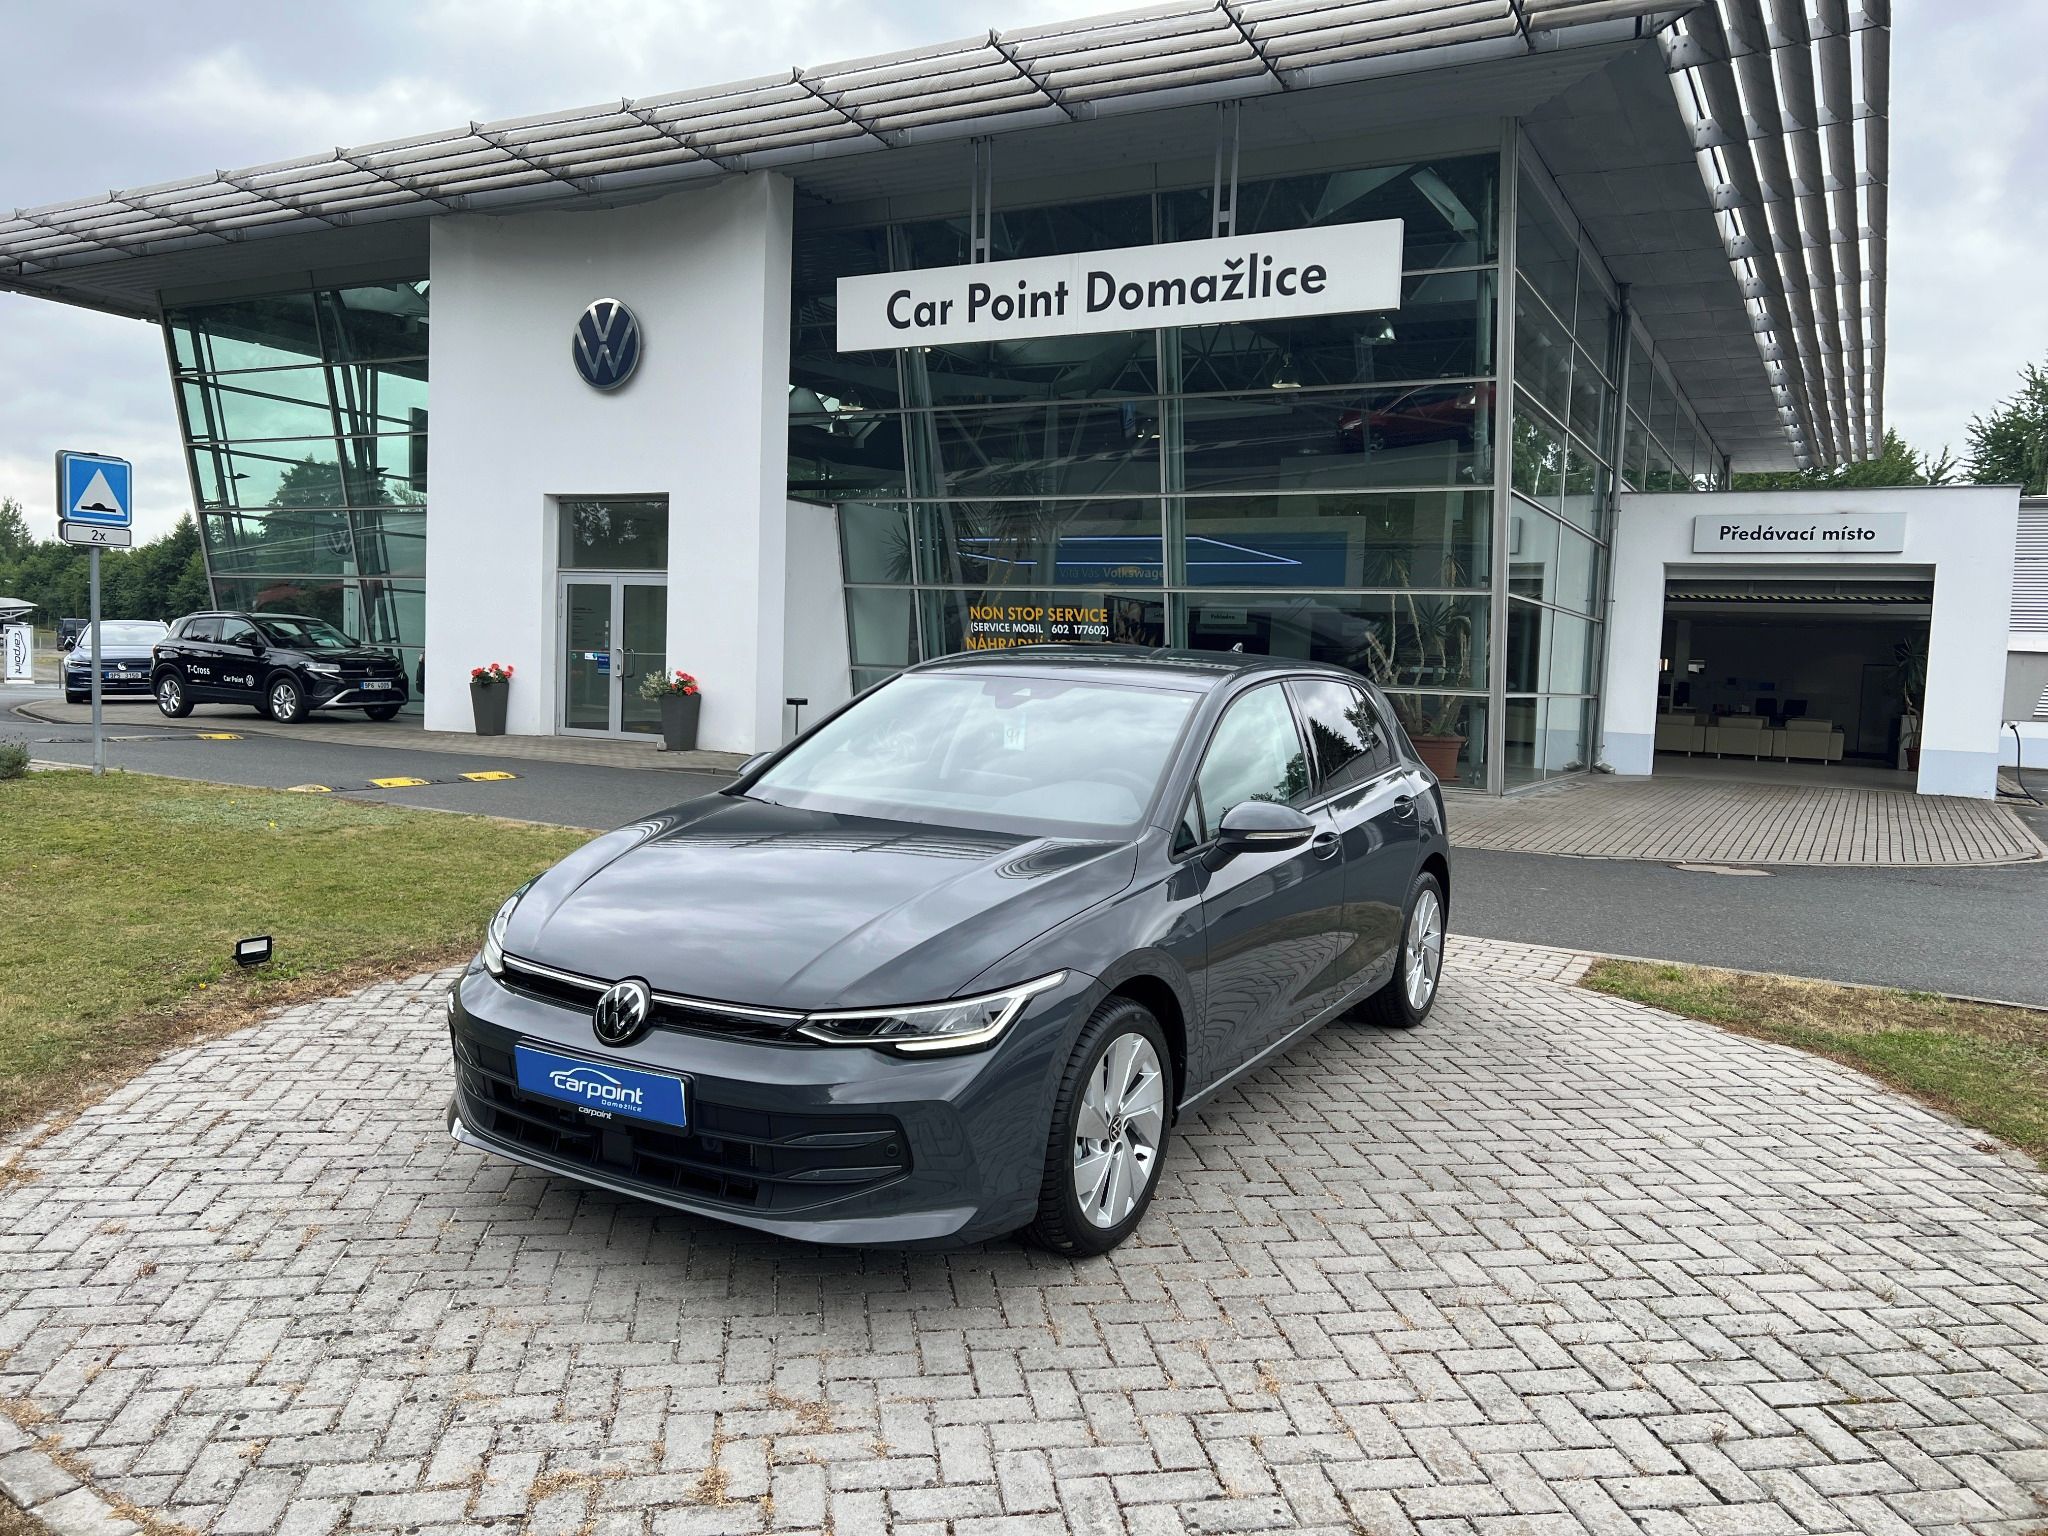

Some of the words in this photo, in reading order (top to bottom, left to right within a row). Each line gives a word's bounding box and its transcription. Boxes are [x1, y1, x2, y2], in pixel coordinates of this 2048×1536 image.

[886, 289, 954, 330] Car
[967, 279, 1069, 324] Point
[1086, 252, 1328, 313] Domažlice
[91, 529, 107, 541] 2x
[1719, 525, 1817, 541] Předávací
[1822, 525, 1876, 541] místo
[970, 606, 1004, 620] NON
[1008, 607, 1044, 621] STOP
[1048, 608, 1108, 622] SERVICE
[970, 622, 1010, 633] (SERVICE
[1012, 623, 1044, 633] MOBIL
[1051, 624, 1070, 634] 602
[1073, 625, 1109, 636] 177602)
[13, 631, 22, 674] carpoint
[186, 664, 211, 675] T-Cross
[223, 674, 232, 682] Car
[232, 676, 244, 684] Point
[554, 1075, 644, 1105] carpoint
[578, 1106, 612, 1120] carpoint
